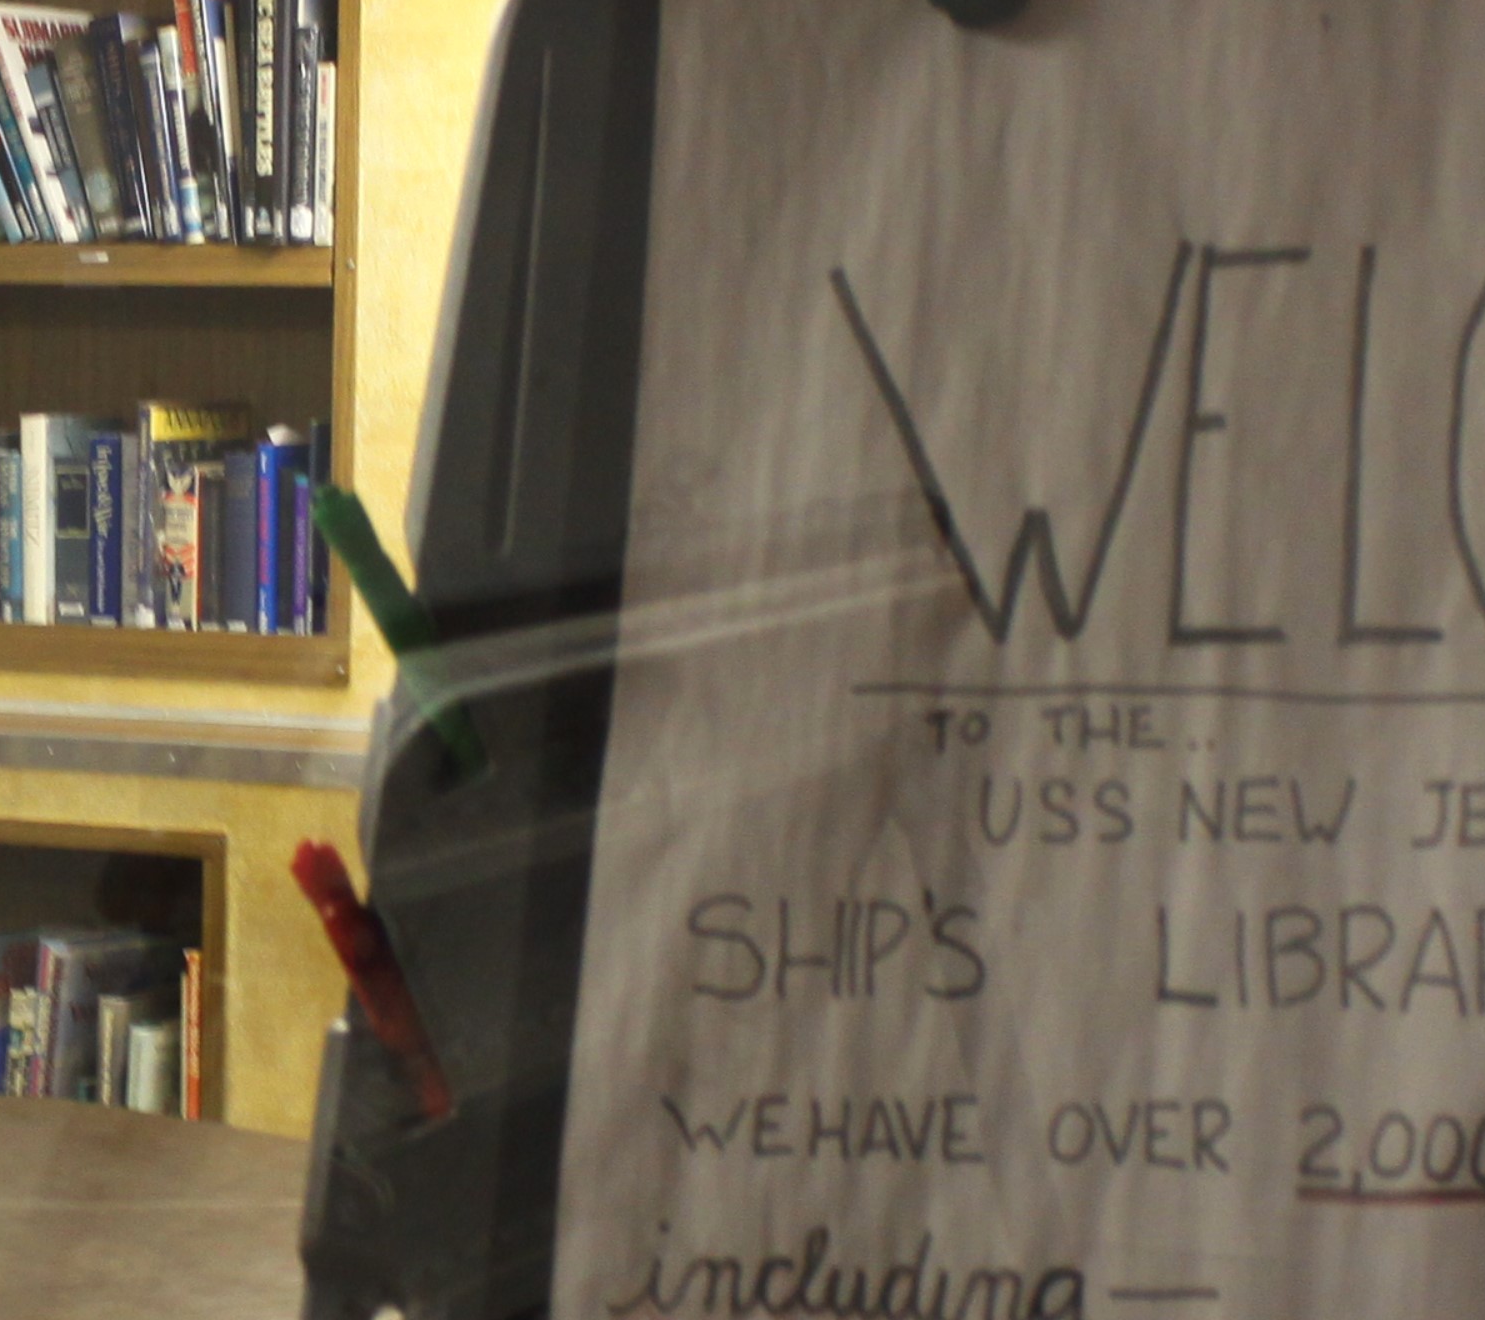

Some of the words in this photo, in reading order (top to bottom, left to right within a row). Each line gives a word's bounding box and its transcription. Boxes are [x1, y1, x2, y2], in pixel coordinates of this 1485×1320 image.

[924, 706, 991, 753] TO
[979, 774, 1134, 849] USS
[1178, 774, 1357, 847] NEW
[687, 888, 988, 1002] SHIP'S
[1046, 1098, 1233, 1175] OVER
